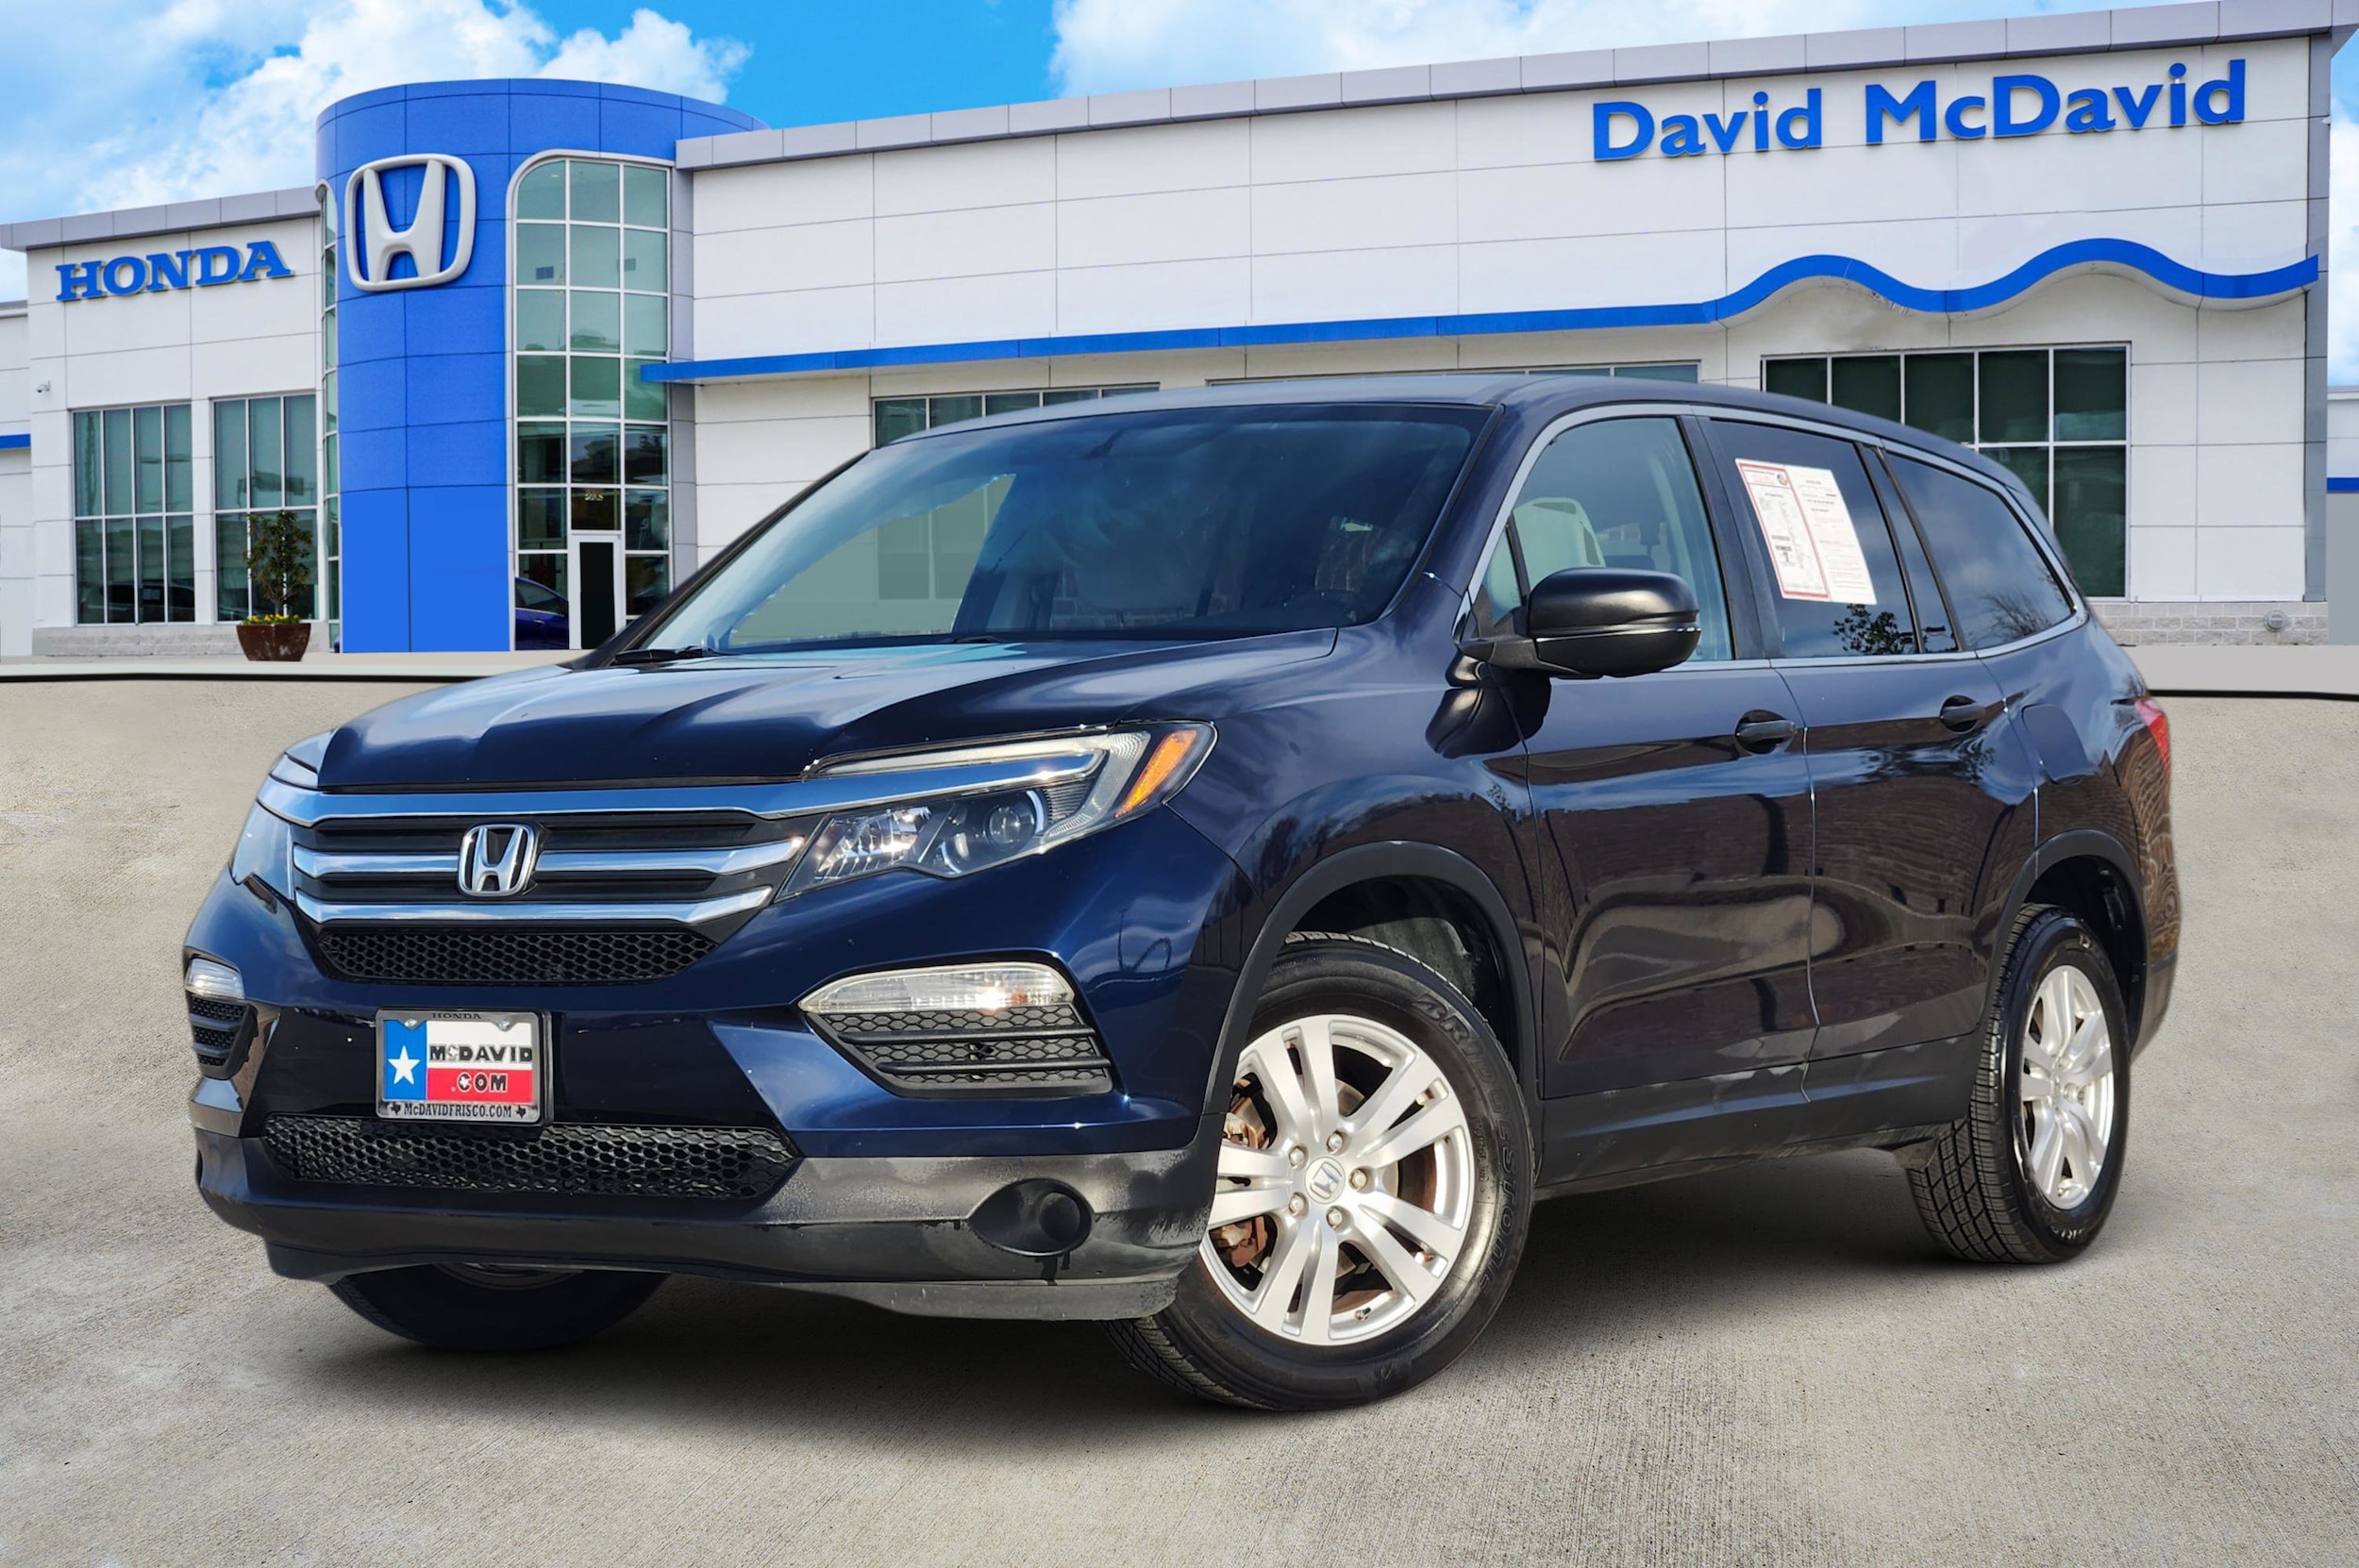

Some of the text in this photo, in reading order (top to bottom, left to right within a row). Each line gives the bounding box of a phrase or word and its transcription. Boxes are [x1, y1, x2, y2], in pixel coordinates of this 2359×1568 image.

[1593, 58, 2247, 162] David McDavid
[55, 240, 295, 302] HONDA
[404, 1103, 511, 1118] McDAVIDFRISCO.COM
